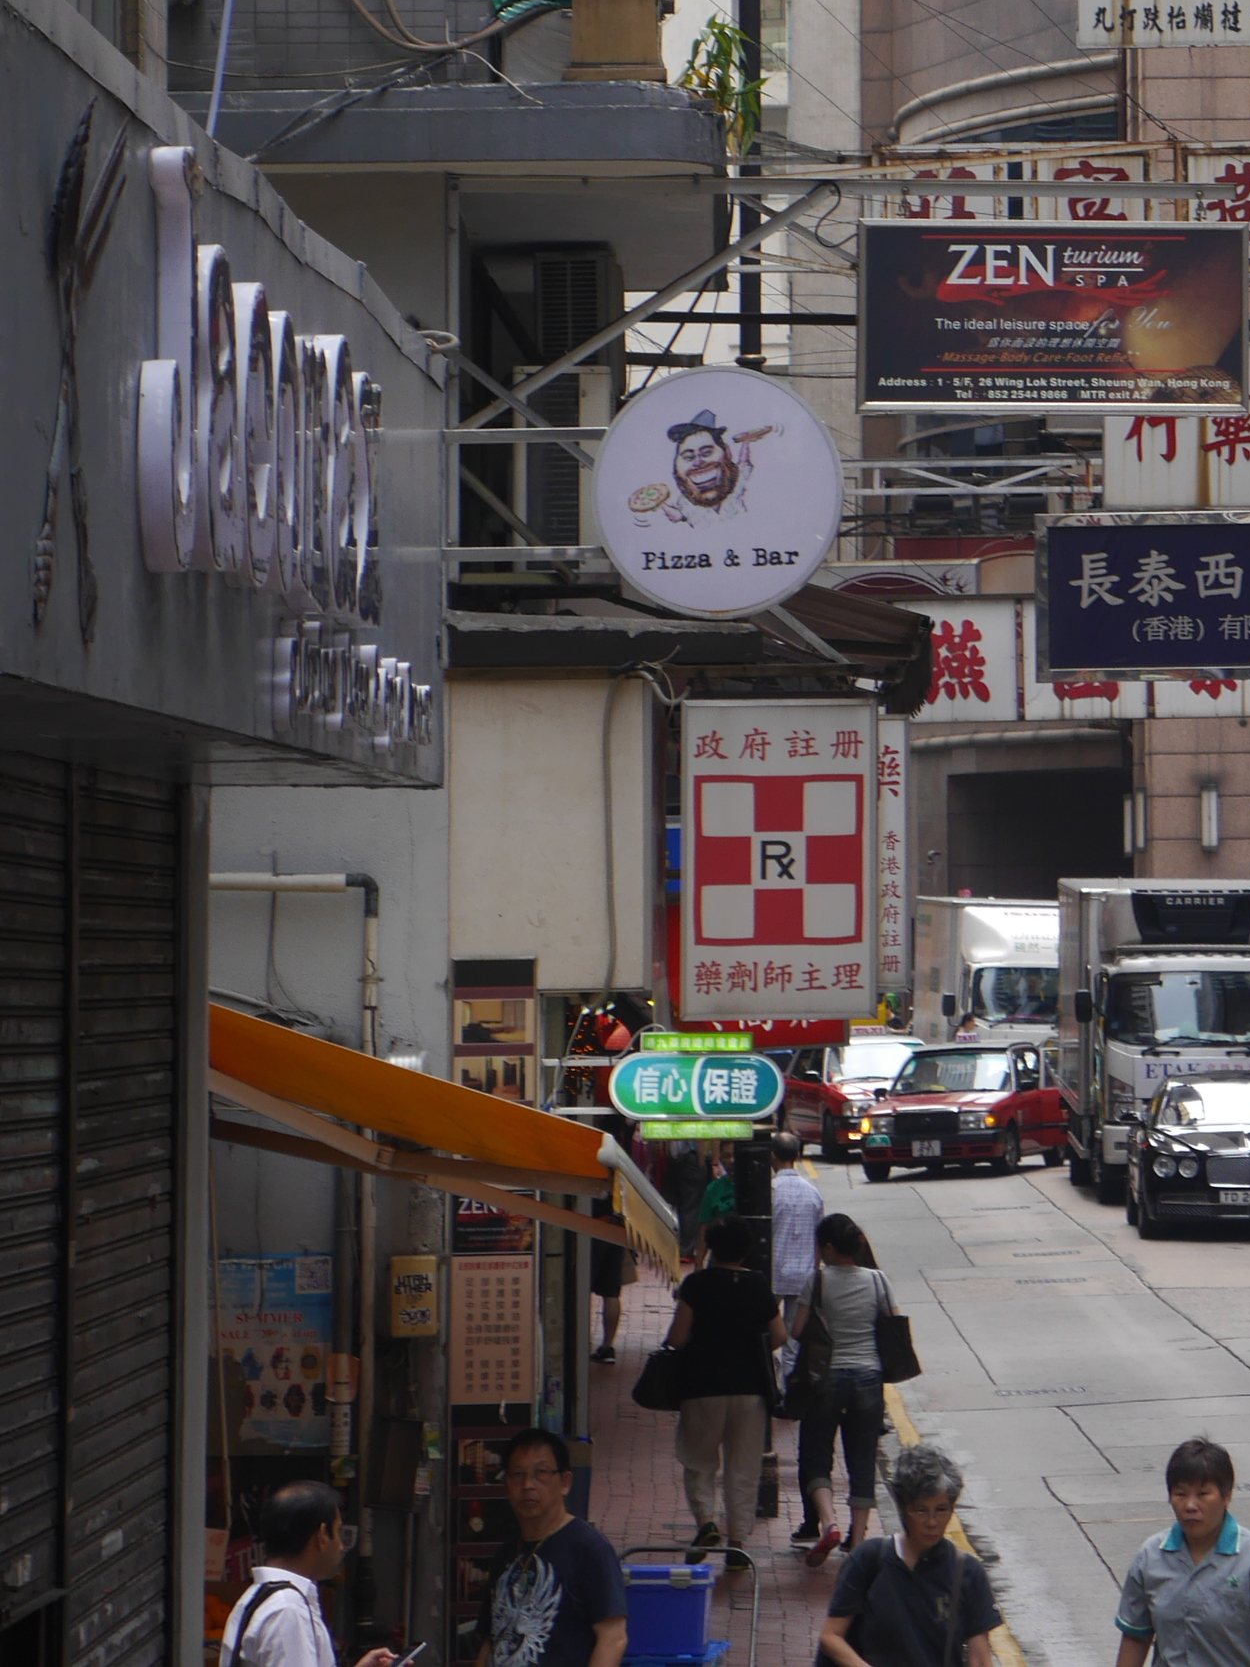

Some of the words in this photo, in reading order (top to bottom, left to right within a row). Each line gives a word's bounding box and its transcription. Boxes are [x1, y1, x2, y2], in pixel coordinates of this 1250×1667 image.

[945, 244, 1057, 288] ZEN
[1062, 244, 1145, 266] turium
[1075, 274, 1129, 288] SPA
[935, 318, 962, 331] The
[964, 317, 997, 331] ideal
[1000, 317, 1046, 331] leisure
[1049, 320, 1089, 335] space
[1131, 306, 1173, 332] You
[878, 377, 928, 388] Address
[978, 377, 993, 387] 26
[994, 377, 1024, 389] Wing
[1026, 377, 1047, 388] Lok
[1049, 377, 1088, 388] Street,
[1091, 377, 1135, 389] Sheung
[1167, 377, 1198, 390] Hong
[1200, 378, 1231, 390] Kong
[955, 390, 973, 400] Tel
[1010, 390, 1038, 400] 2544
[1040, 390, 1068, 400] 9866
[1108, 390, 1130, 400] exit
[641, 551, 712, 571] Pizza
[723, 549, 741, 568] &
[752, 548, 800, 568] Bar
[1166, 896, 1226, 906] CARRIER
[694, 960, 865, 996] 藥劑師主理
[854, 1027, 885, 1036] TAXI
